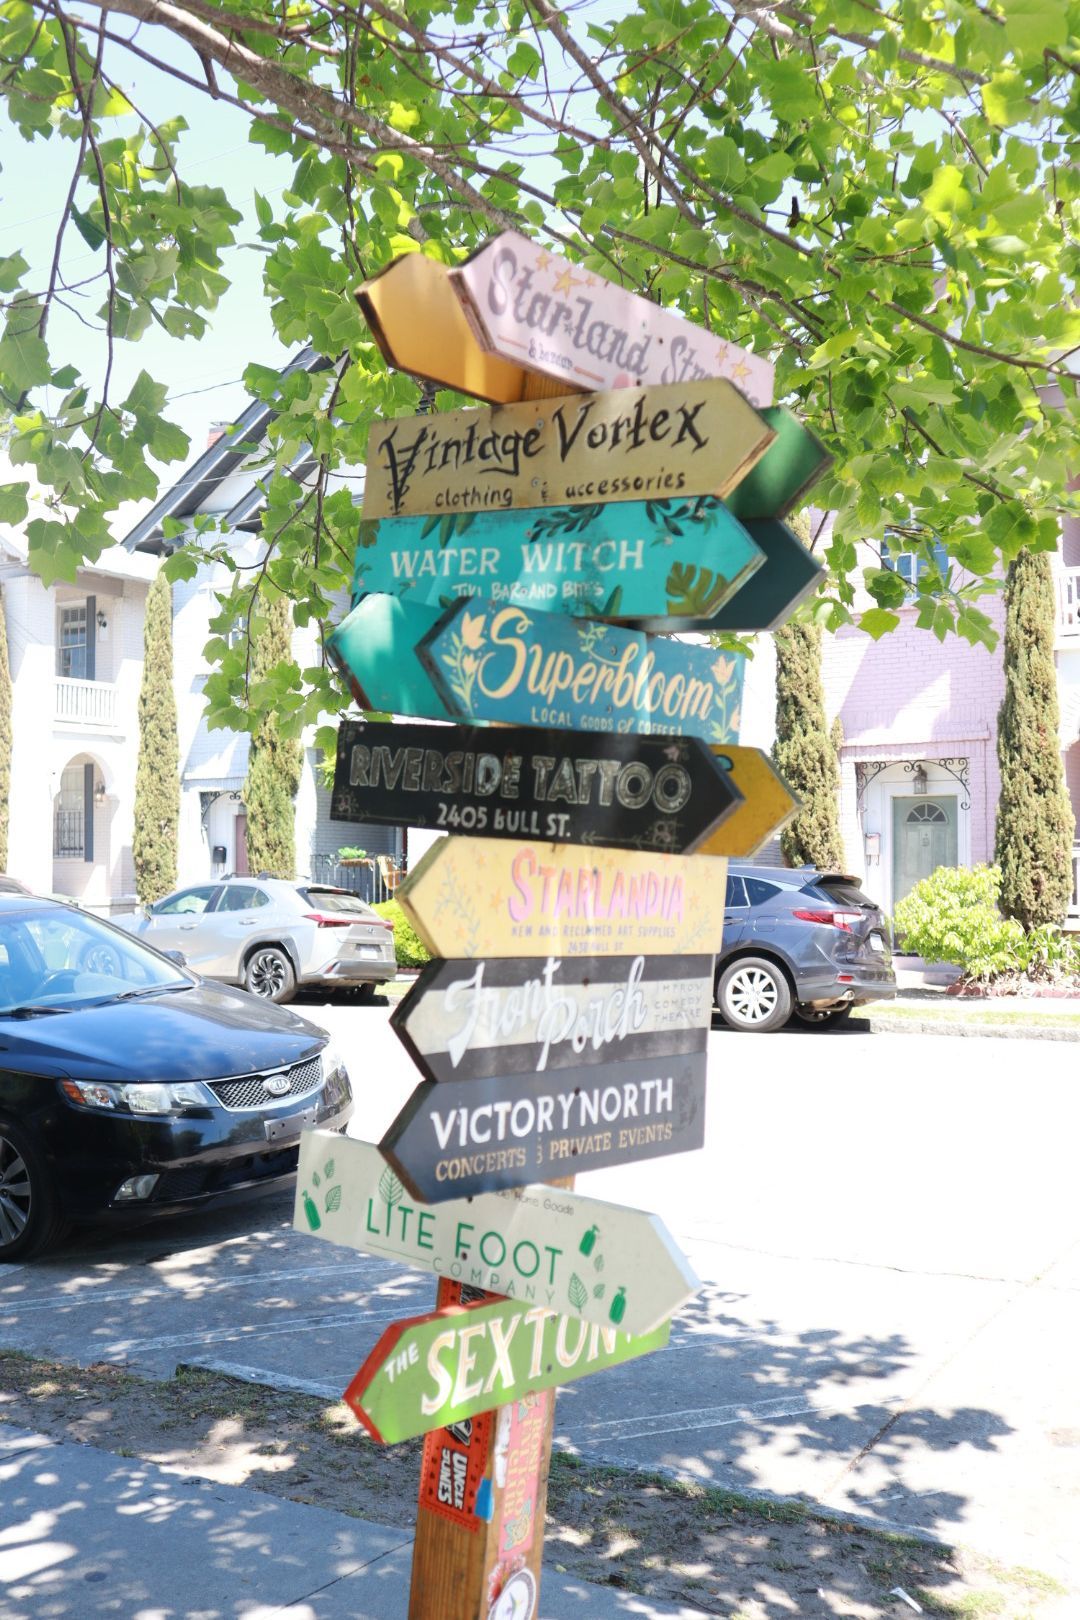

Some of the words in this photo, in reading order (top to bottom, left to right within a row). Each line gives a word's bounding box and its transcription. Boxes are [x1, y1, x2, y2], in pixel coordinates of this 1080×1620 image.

[487, 246, 652, 377] Starland
[378, 420, 545, 515] Vintage
[552, 394, 709, 463] Vortex
[435, 484, 513, 508] clothing
[565, 467, 686, 499] accessories
[389, 546, 501, 578] WATER
[520, 539, 645, 574] WITCH
[491, 581, 521, 600] BAR
[528, 581, 558, 600] AND
[476, 607, 714, 721] Superbloom
[531, 706, 573, 727] LOCAL
[580, 715, 614, 731] GOODS
[349, 744, 522, 800] RIVERSIDE
[531, 754, 693, 814] TATTOO
[437, 802, 488, 830] 2405
[495, 806, 541, 834] BULL
[546, 813, 571, 838] ST.
[508, 846, 685, 924] STARLANDIA
[511, 925, 533, 937] NEW
[539, 925, 558, 937] AND
[618, 925, 633, 937] ART
[638, 926, 677, 938] SUPPLIES
[444, 956, 561, 1069] Front
[535, 955, 648, 1072] Porch
[654, 996, 702, 1010] COMEDY
[435, 1147, 526, 1182] CONCERTS
[549, 1135, 612, 1161] PRIVATE
[619, 1123, 673, 1150] EVENTS
[543, 1198, 575, 1217] Goods
[366, 1198, 436, 1249] LITE
[454, 1222, 563, 1285] FOOT
[432, 1256, 556, 1302] COMPANY
[384, 1343, 420, 1384] THE
[452, 1451, 468, 1510] UNCLE
